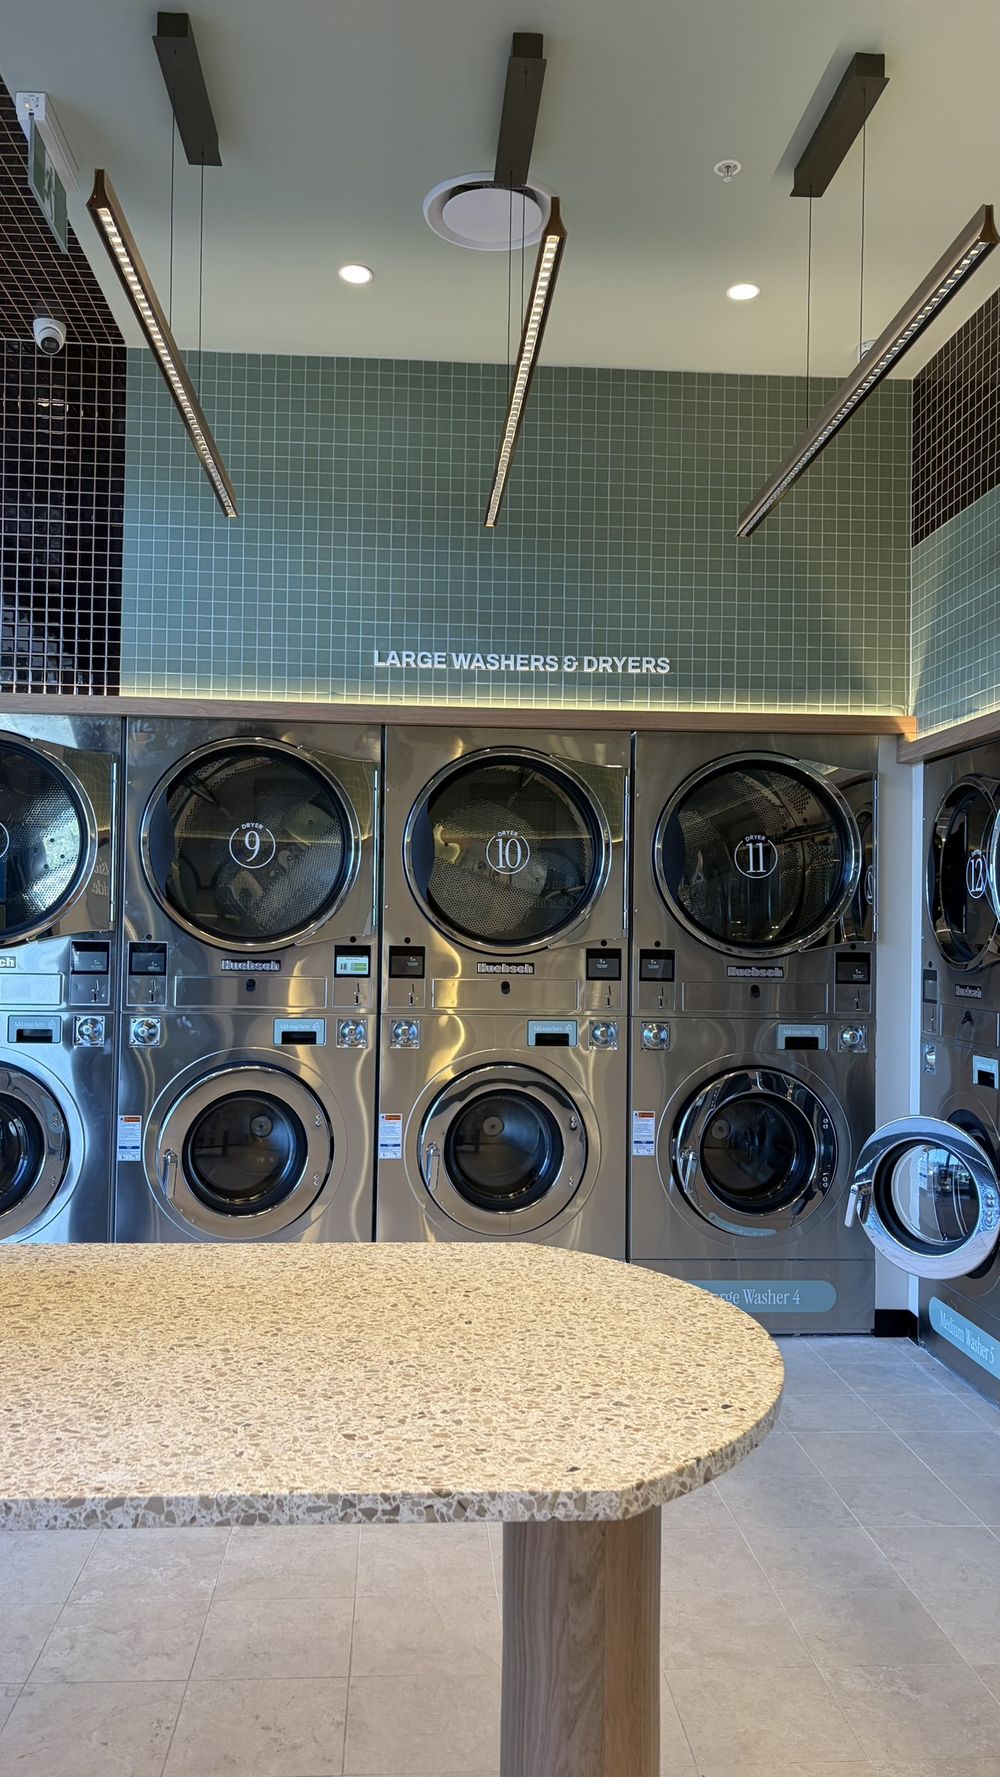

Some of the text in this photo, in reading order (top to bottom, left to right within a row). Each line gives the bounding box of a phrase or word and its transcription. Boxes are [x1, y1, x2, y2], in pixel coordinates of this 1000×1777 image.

[373, 650, 671, 674] LARGE WASHERS & DRYERS
[241, 822, 264, 830] DRYER
[744, 834, 766, 842] DRYER
[244, 830, 261, 862] 9
[495, 838, 522, 869] 10
[745, 842, 767, 873] 11
[970, 857, 984, 892] 12
[742, 1288, 789, 1305] Washer
[792, 1289, 801, 1305] 4
[939, 1309, 995, 1365] Medium Washer 5
